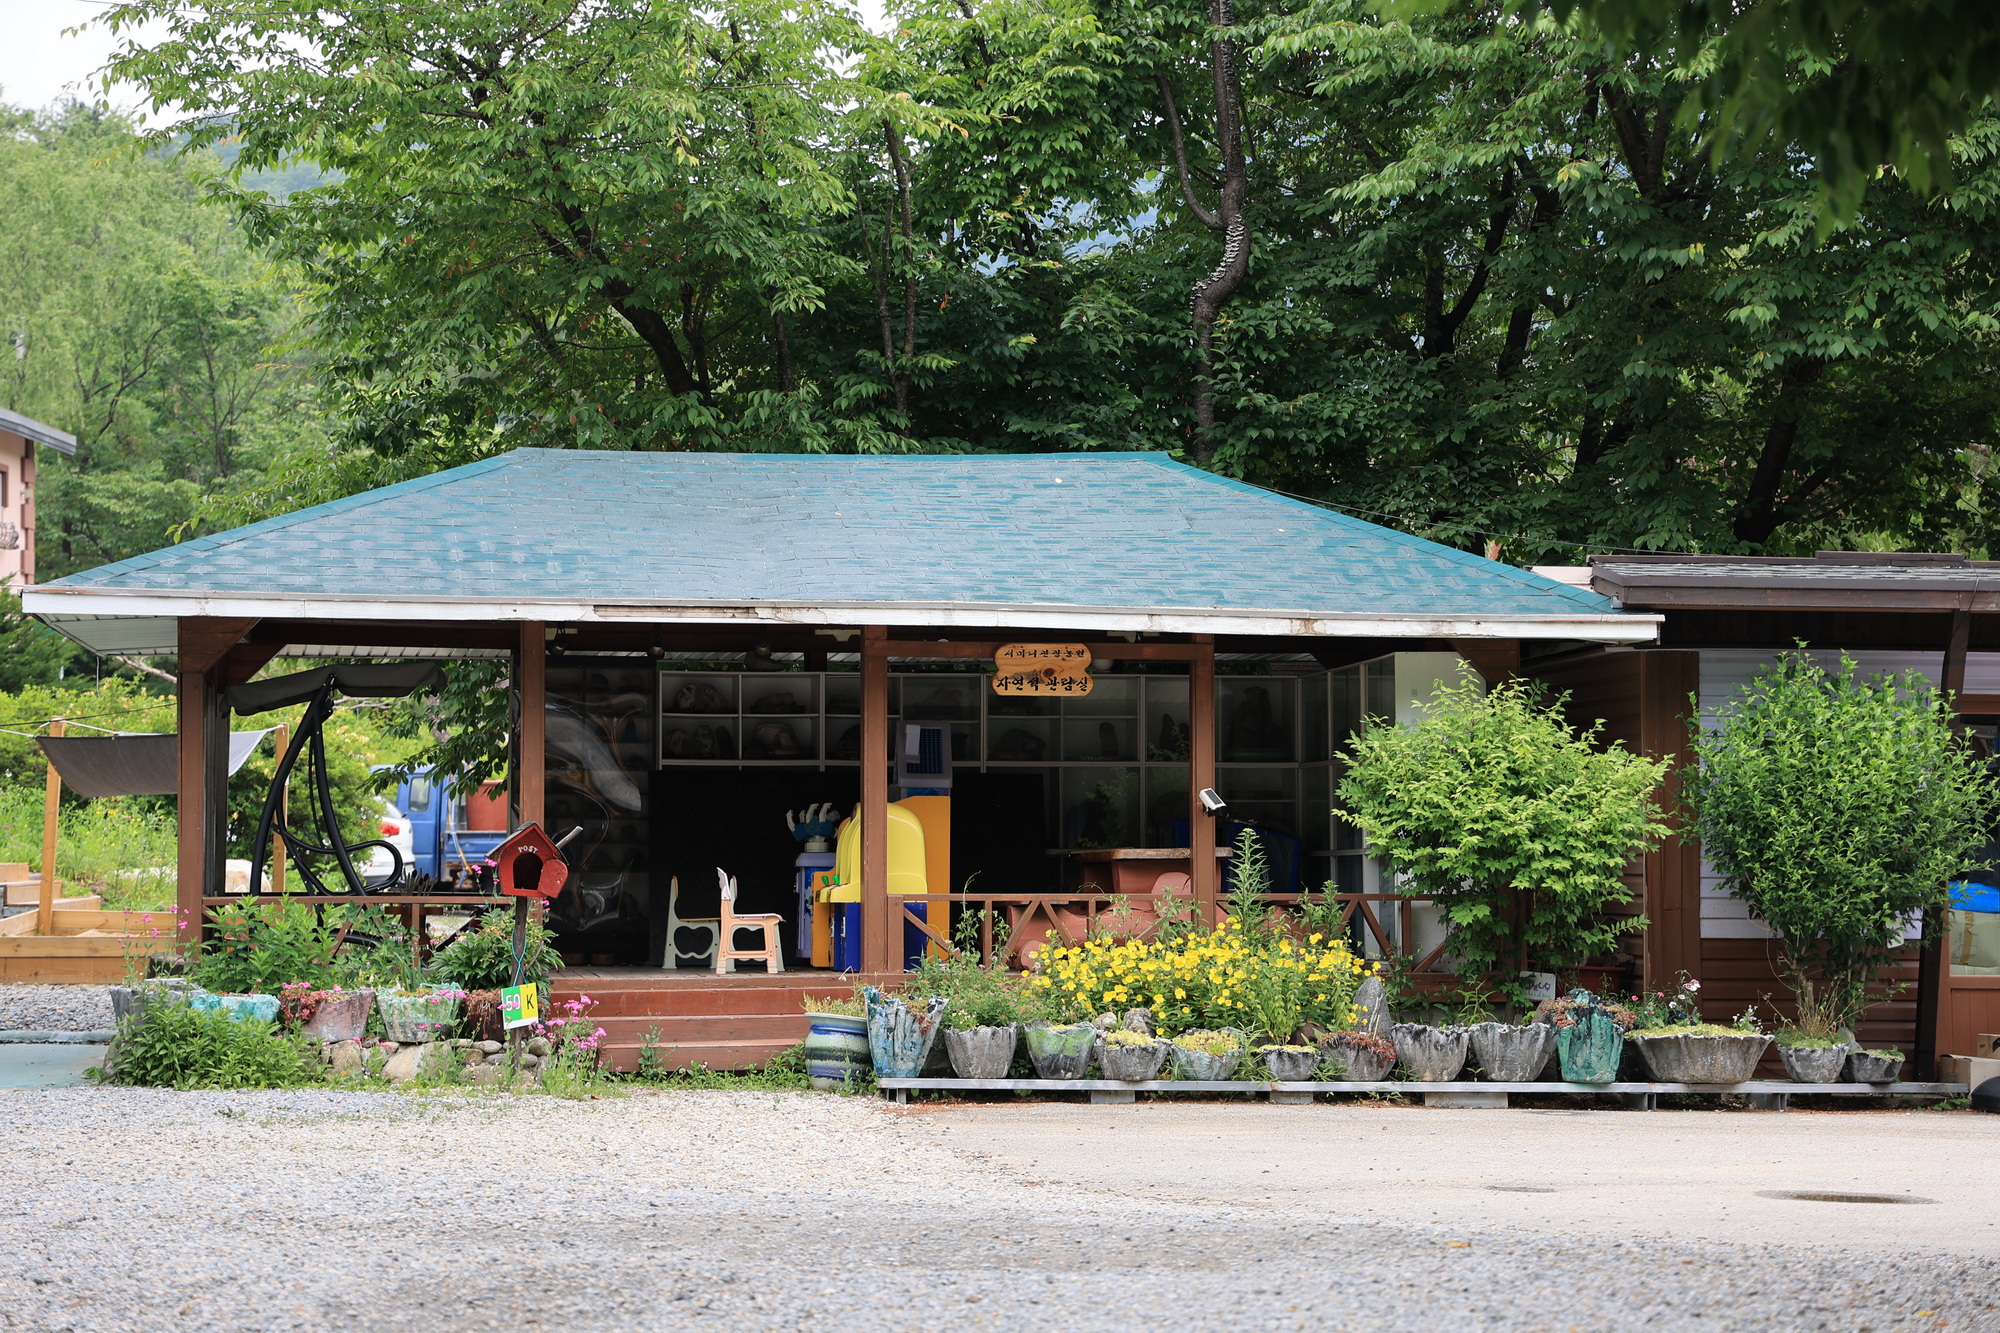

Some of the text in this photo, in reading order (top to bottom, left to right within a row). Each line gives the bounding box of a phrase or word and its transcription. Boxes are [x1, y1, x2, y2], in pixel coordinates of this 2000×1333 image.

[1045, 676, 1088, 692] 관람실
[518, 845, 538, 853] POST
[526, 993, 535, 1010] K
